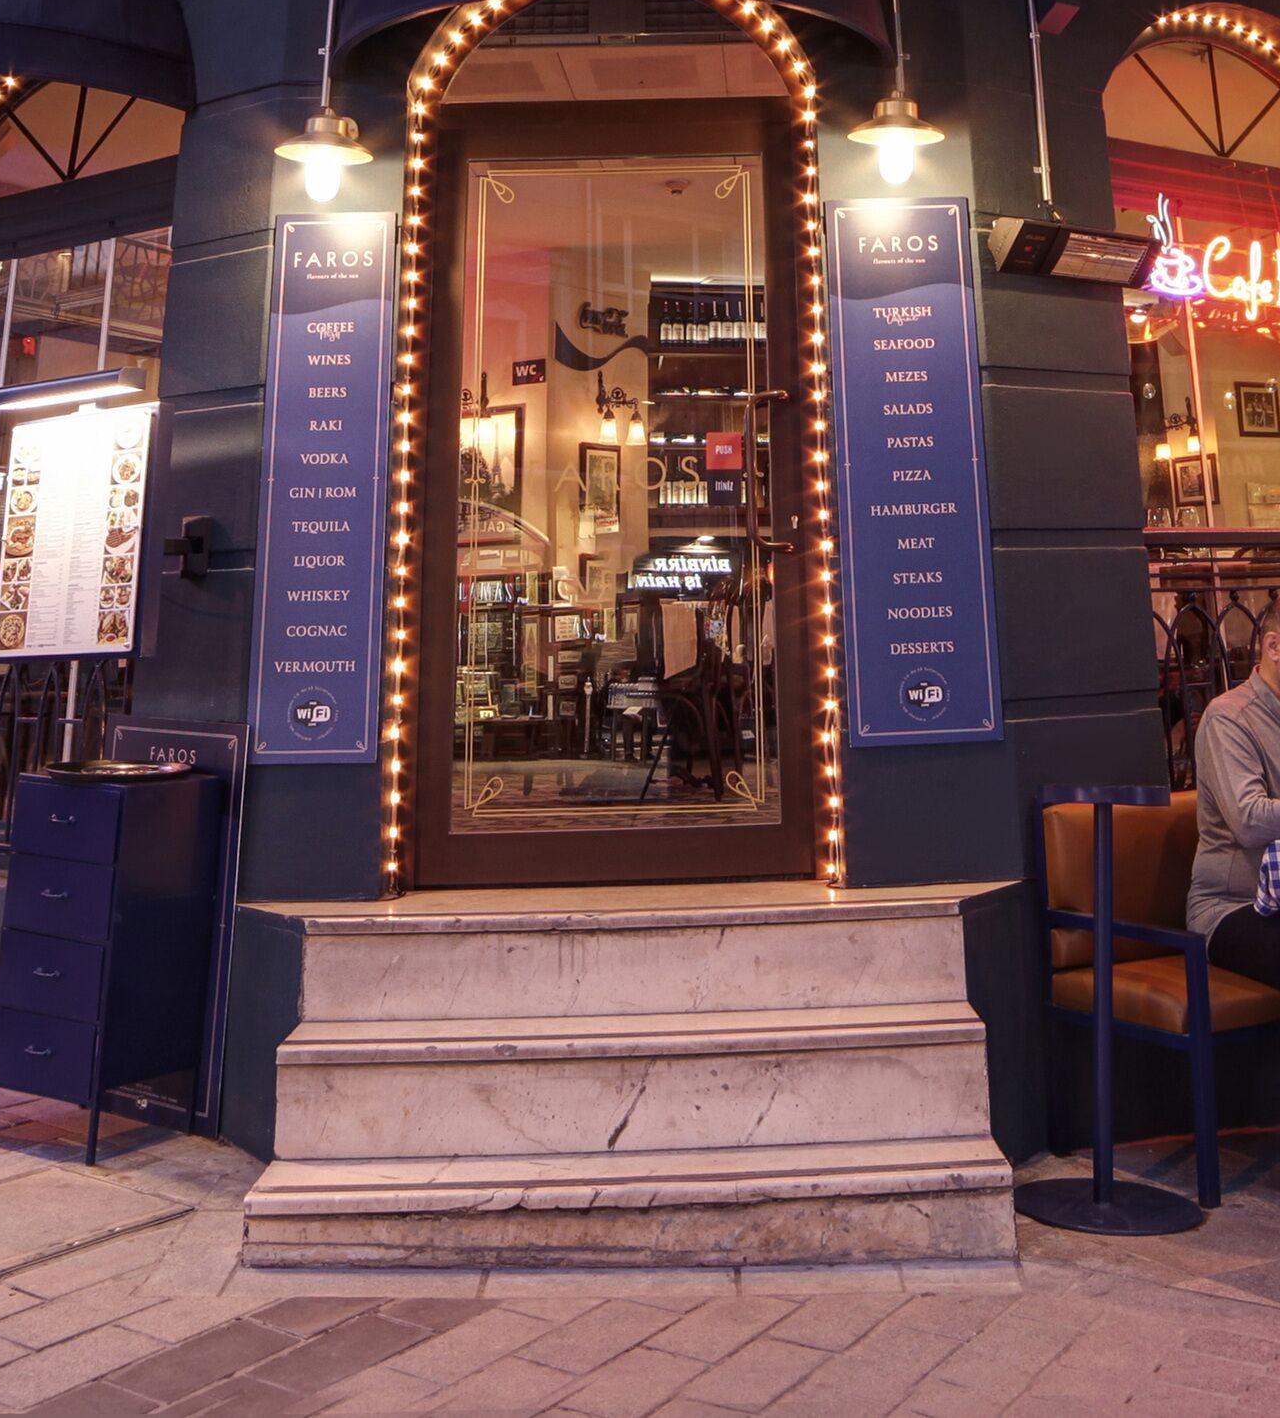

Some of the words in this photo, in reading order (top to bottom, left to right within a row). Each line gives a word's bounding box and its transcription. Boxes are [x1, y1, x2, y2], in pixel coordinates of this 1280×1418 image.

[858, 235, 939, 254] FAROS
[293, 250, 375, 268] FAROS
[1202, 236, 1274, 320] Cafe
[873, 306, 932, 319] TURKISH
[307, 322, 355, 333] COFFEE
[873, 338, 935, 351] SEAFOOD
[307, 354, 351, 365] WINES
[515, 364, 537, 378] WC
[885, 370, 928, 383] MEZES
[308, 387, 347, 398] BEERS
[883, 403, 934, 416] SALADS
[309, 420, 342, 431] RAKI
[887, 436, 934, 448] PASTAS
[715, 445, 733, 455] PUSH
[300, 453, 349, 464] VODKA
[892, 469, 932, 481] PIZZA
[289, 487, 315, 498] GIN
[325, 486, 357, 498] ROM
[870, 502, 958, 516] HAMBURGER
[292, 521, 350, 534] TEQUILA
[897, 537, 935, 550] MEAT
[293, 555, 346, 569] LIQUOR
[893, 571, 943, 584] STEAKS
[287, 590, 350, 602] WHISKEY
[887, 605, 953, 620] NOODLES
[286, 625, 347, 637] COGNAC
[890, 641, 955, 655] DESSERTS
[274, 660, 356, 673] VERMOUTH
[149, 746, 197, 765] FAROS
